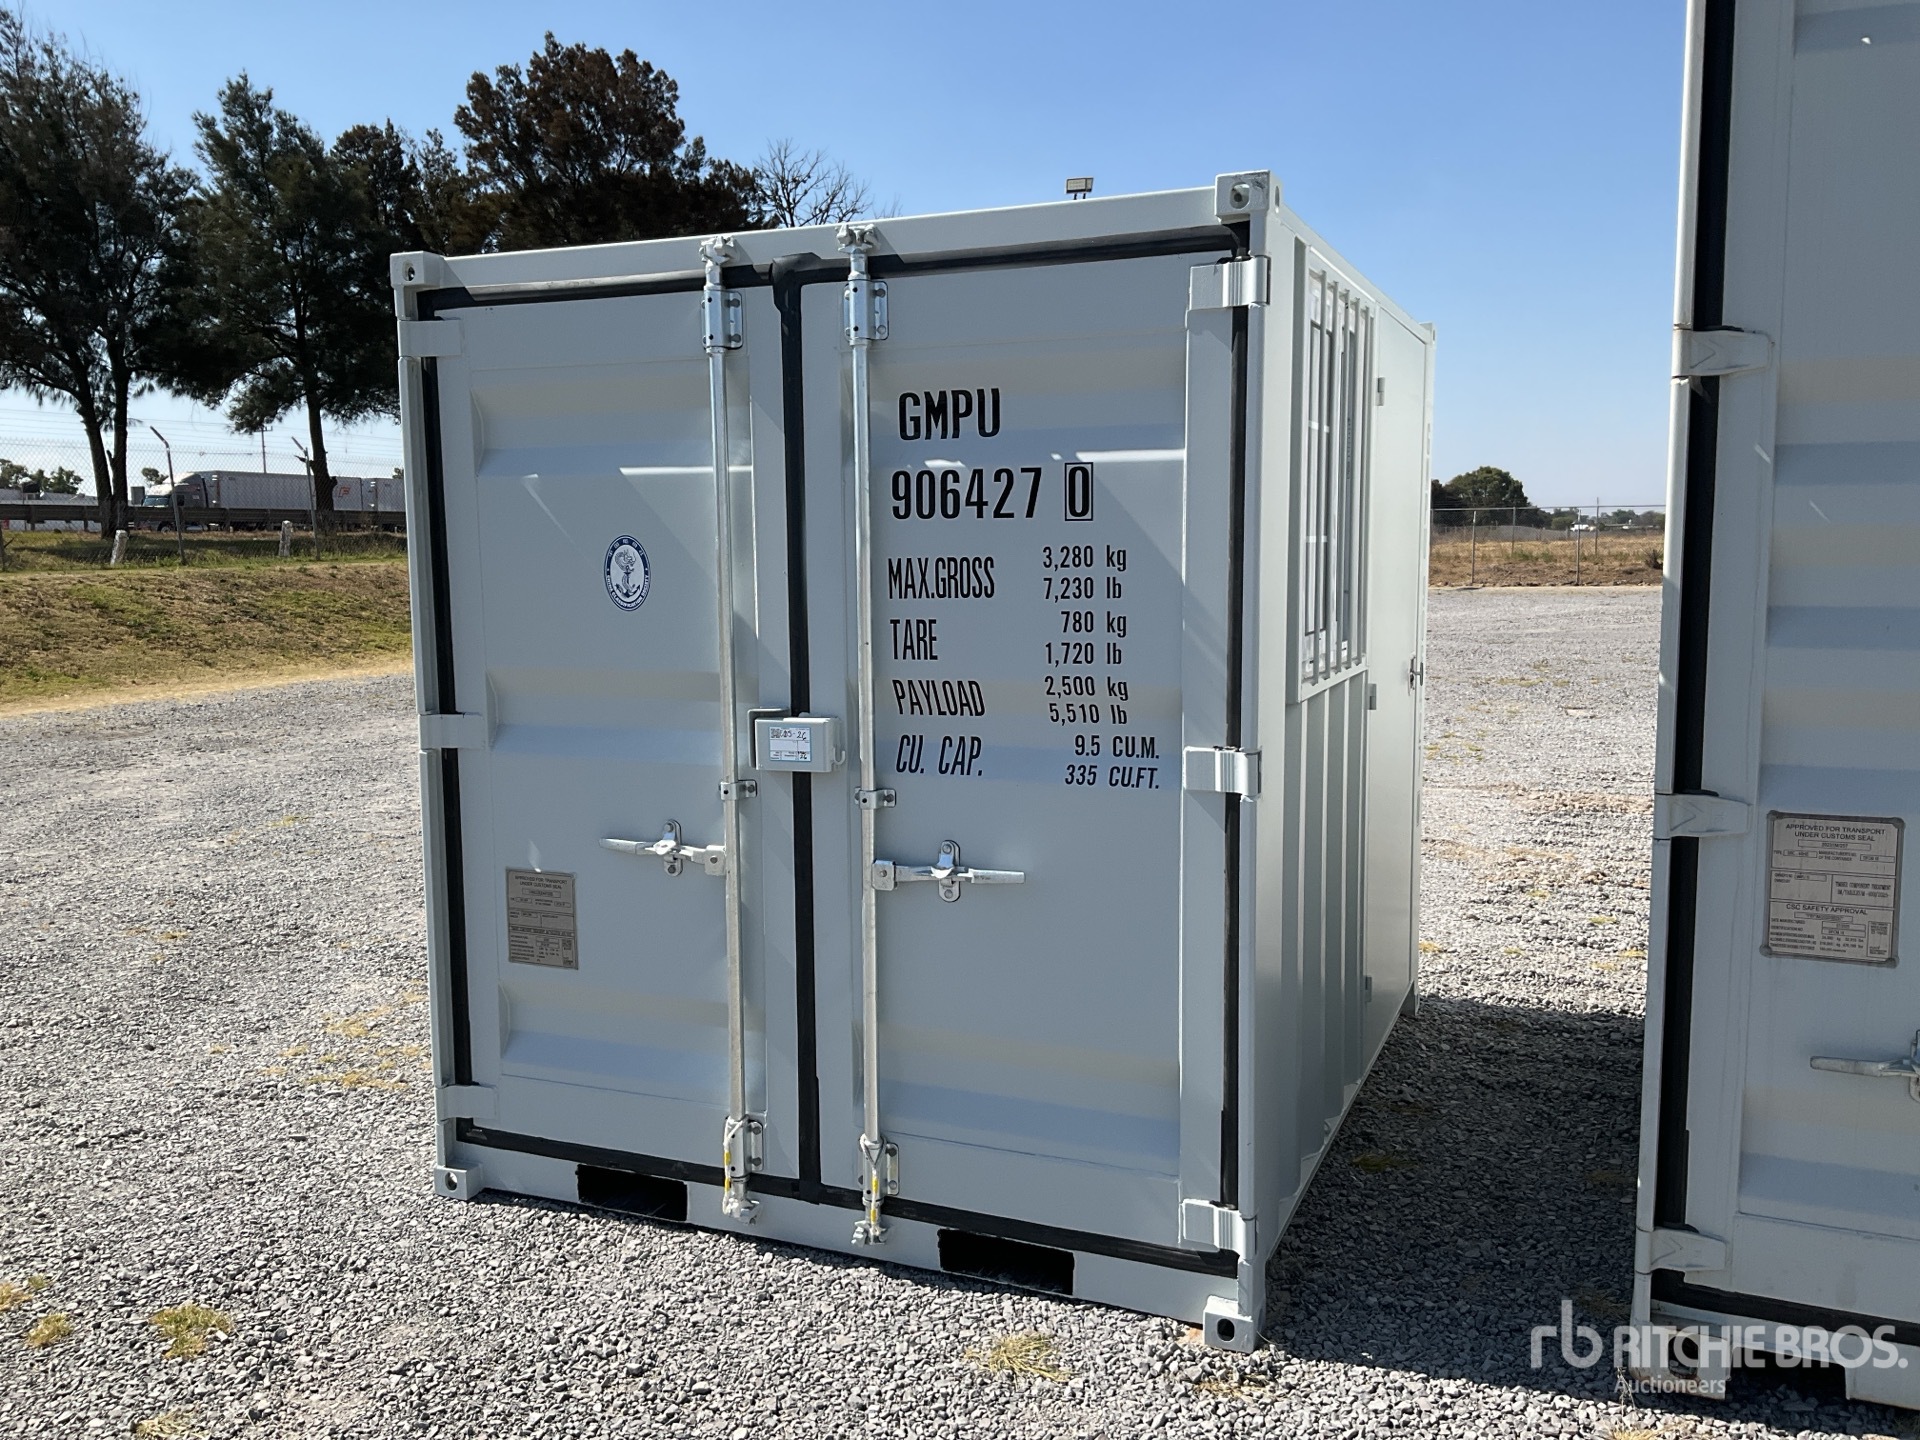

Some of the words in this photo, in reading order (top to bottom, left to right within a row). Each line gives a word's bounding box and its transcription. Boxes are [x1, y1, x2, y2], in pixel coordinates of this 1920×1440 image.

[899, 388, 1000, 440] GMPU
[892, 468, 1041, 519] 906427
[1068, 466, 1090, 517] 0
[1043, 546, 1093, 571] 3,280
[1107, 545, 1126, 571] kg
[888, 557, 994, 599] MAX.GROSS
[1044, 577, 1093, 603] 7,230
[1107, 577, 1121, 598] lb
[1061, 611, 1093, 632] 780
[1107, 611, 1126, 637] kg
[890, 619, 937, 660] TARE
[1046, 643, 1093, 667] 1,720
[1107, 643, 1121, 664] lb
[892, 680, 985, 716] PAYLOAD
[1045, 676, 1095, 698] 2,500
[1108, 677, 1128, 701] kg
[1050, 703, 1099, 726] 5,510
[1111, 705, 1127, 724] lb
[896, 735, 924, 773] CU.
[939, 736, 982, 776] CAP.
[1075, 735, 1100, 756] 9.5
[1113, 736, 1159, 758] CU.M.
[1065, 765, 1097, 785] 335
[1109, 767, 1158, 789] CU.FT.
[1821, 832, 1856, 841] CUSTOMS
[1857, 834, 1875, 842] SEAL
[1825, 825, 1840, 833] FOR
[1843, 827, 1885, 835] TRANSPORT
[1786, 903, 1801, 911] CSC
[1802, 905, 1829, 913] SAFETY
[1831, 906, 1868, 915] APPROVAL
